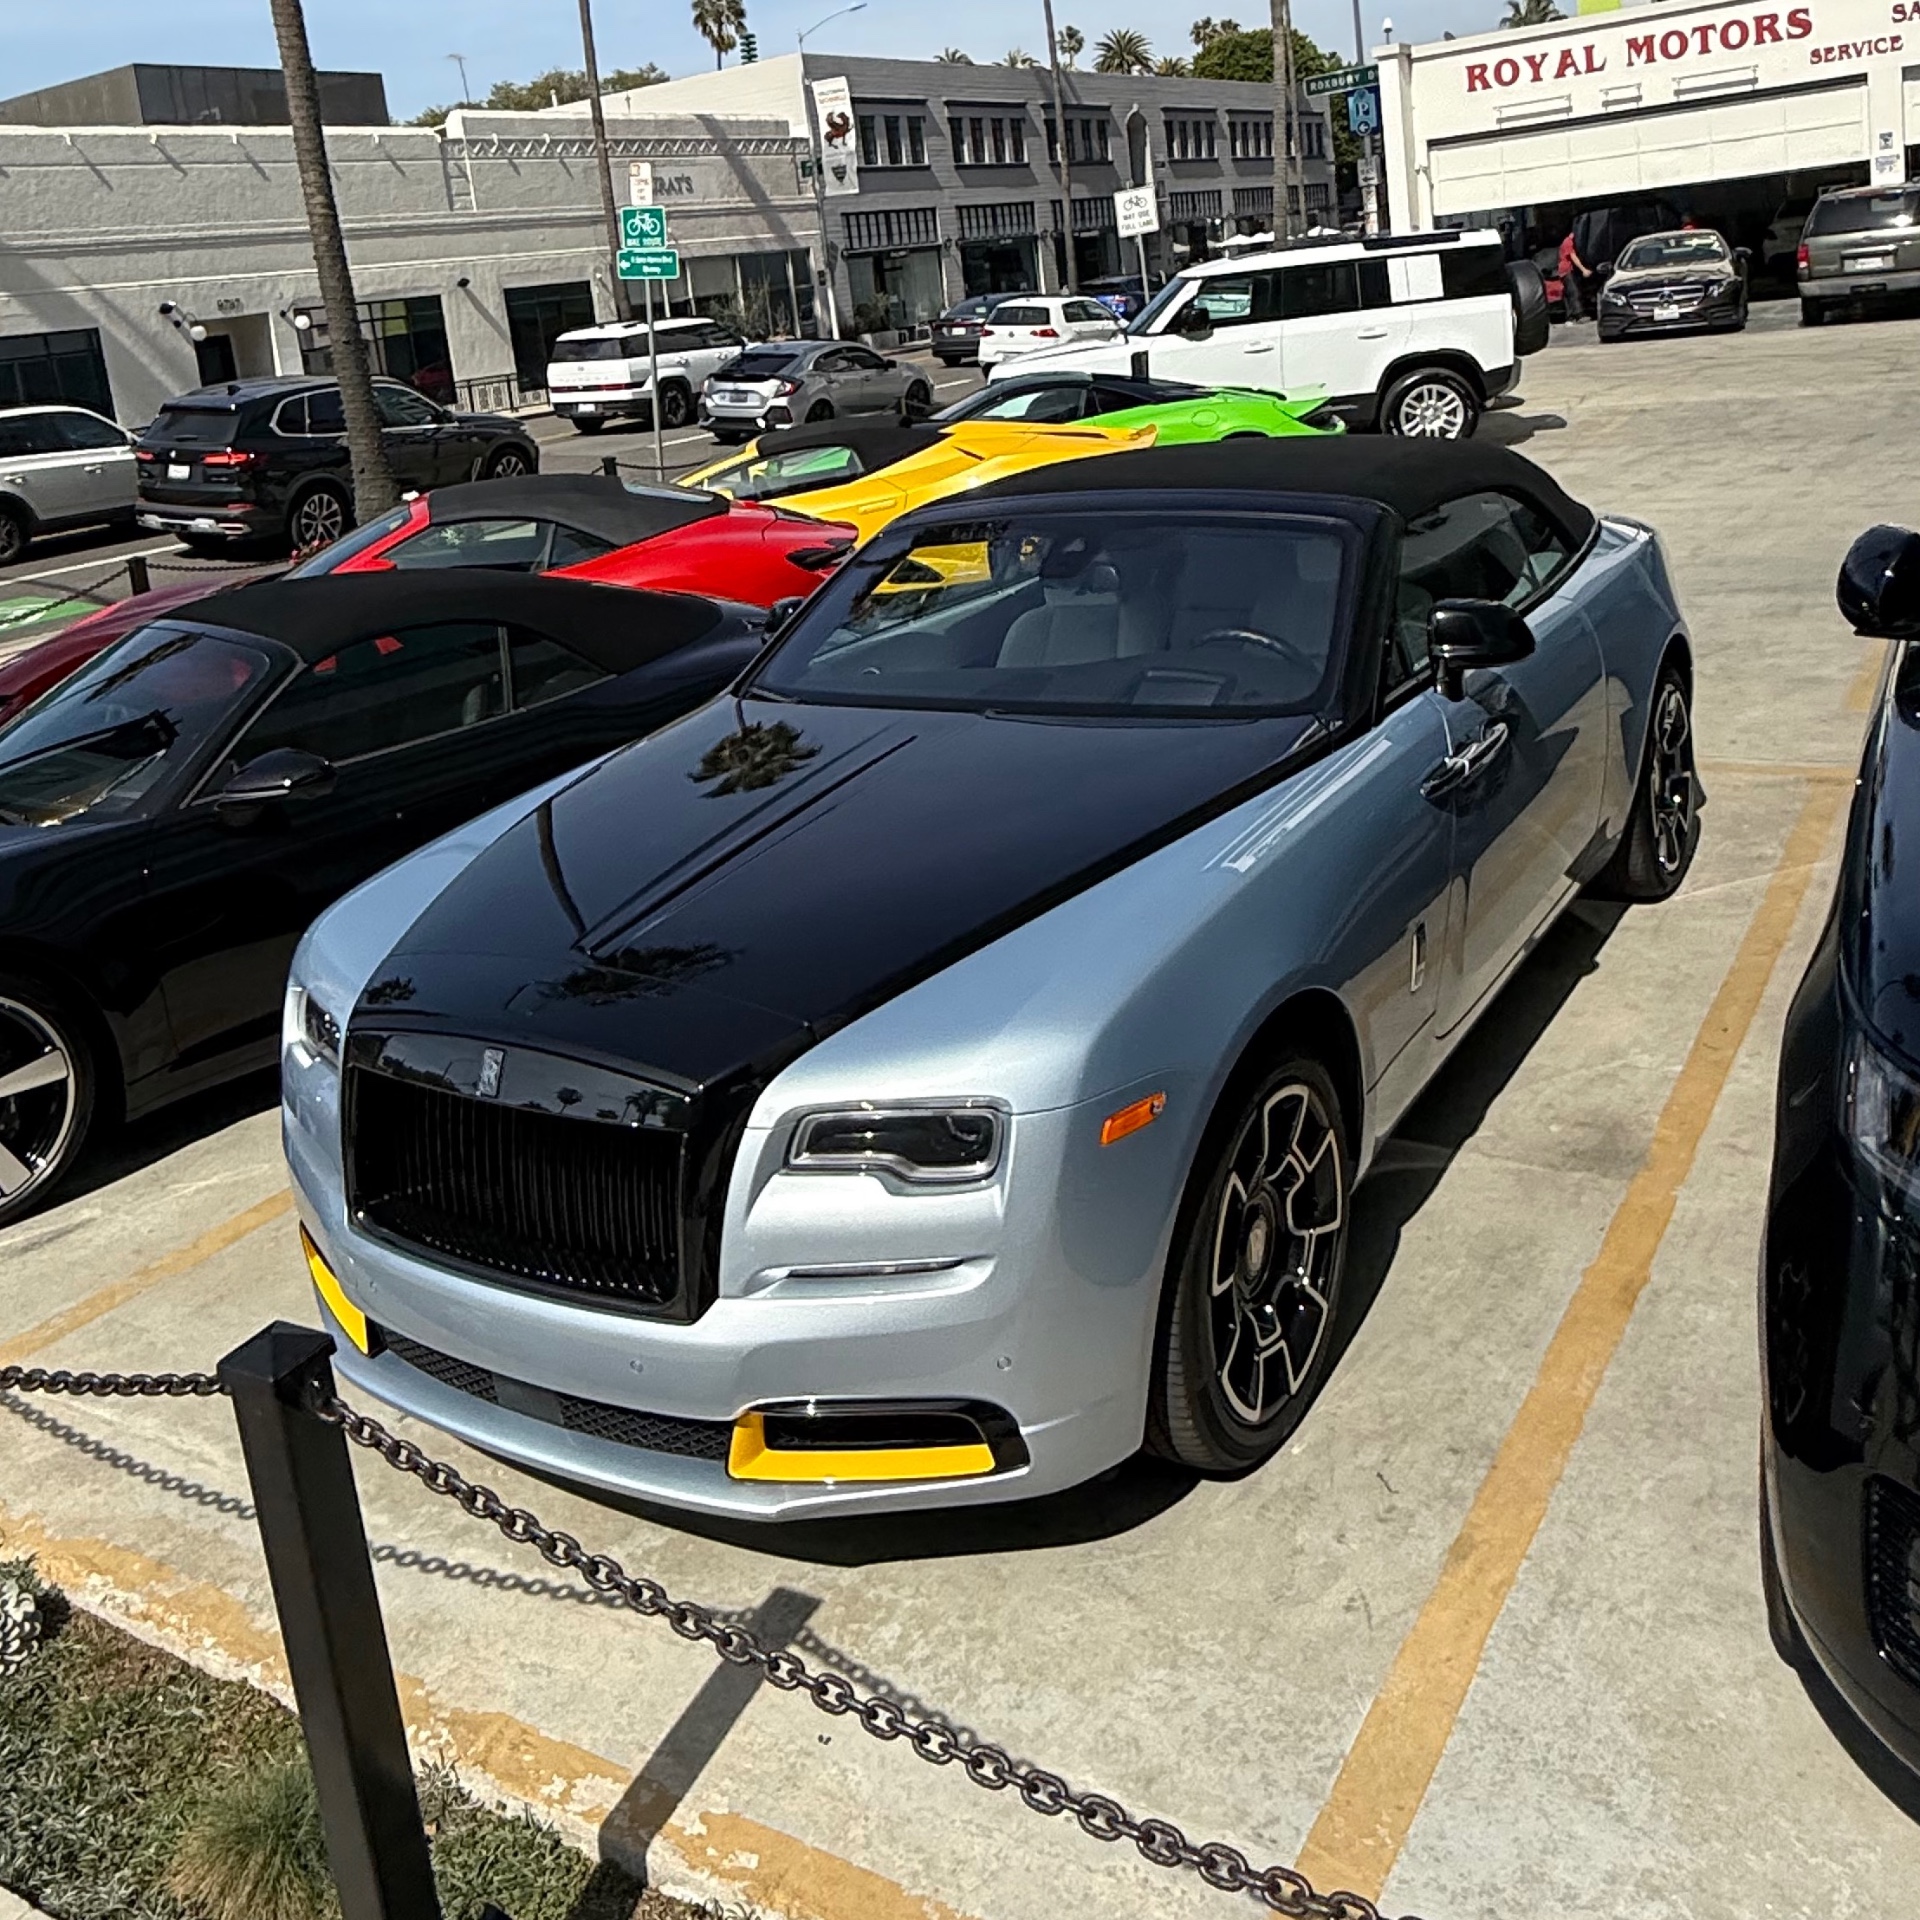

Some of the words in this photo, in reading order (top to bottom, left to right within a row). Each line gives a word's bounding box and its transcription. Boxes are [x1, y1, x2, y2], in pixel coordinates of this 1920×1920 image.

[1465, 44, 1607, 93] ROYAL
[1625, 8, 1813, 68] MOTORS
[1810, 35, 1904, 65] SERVICE
[1310, 73, 1360, 92] ROXBURY
